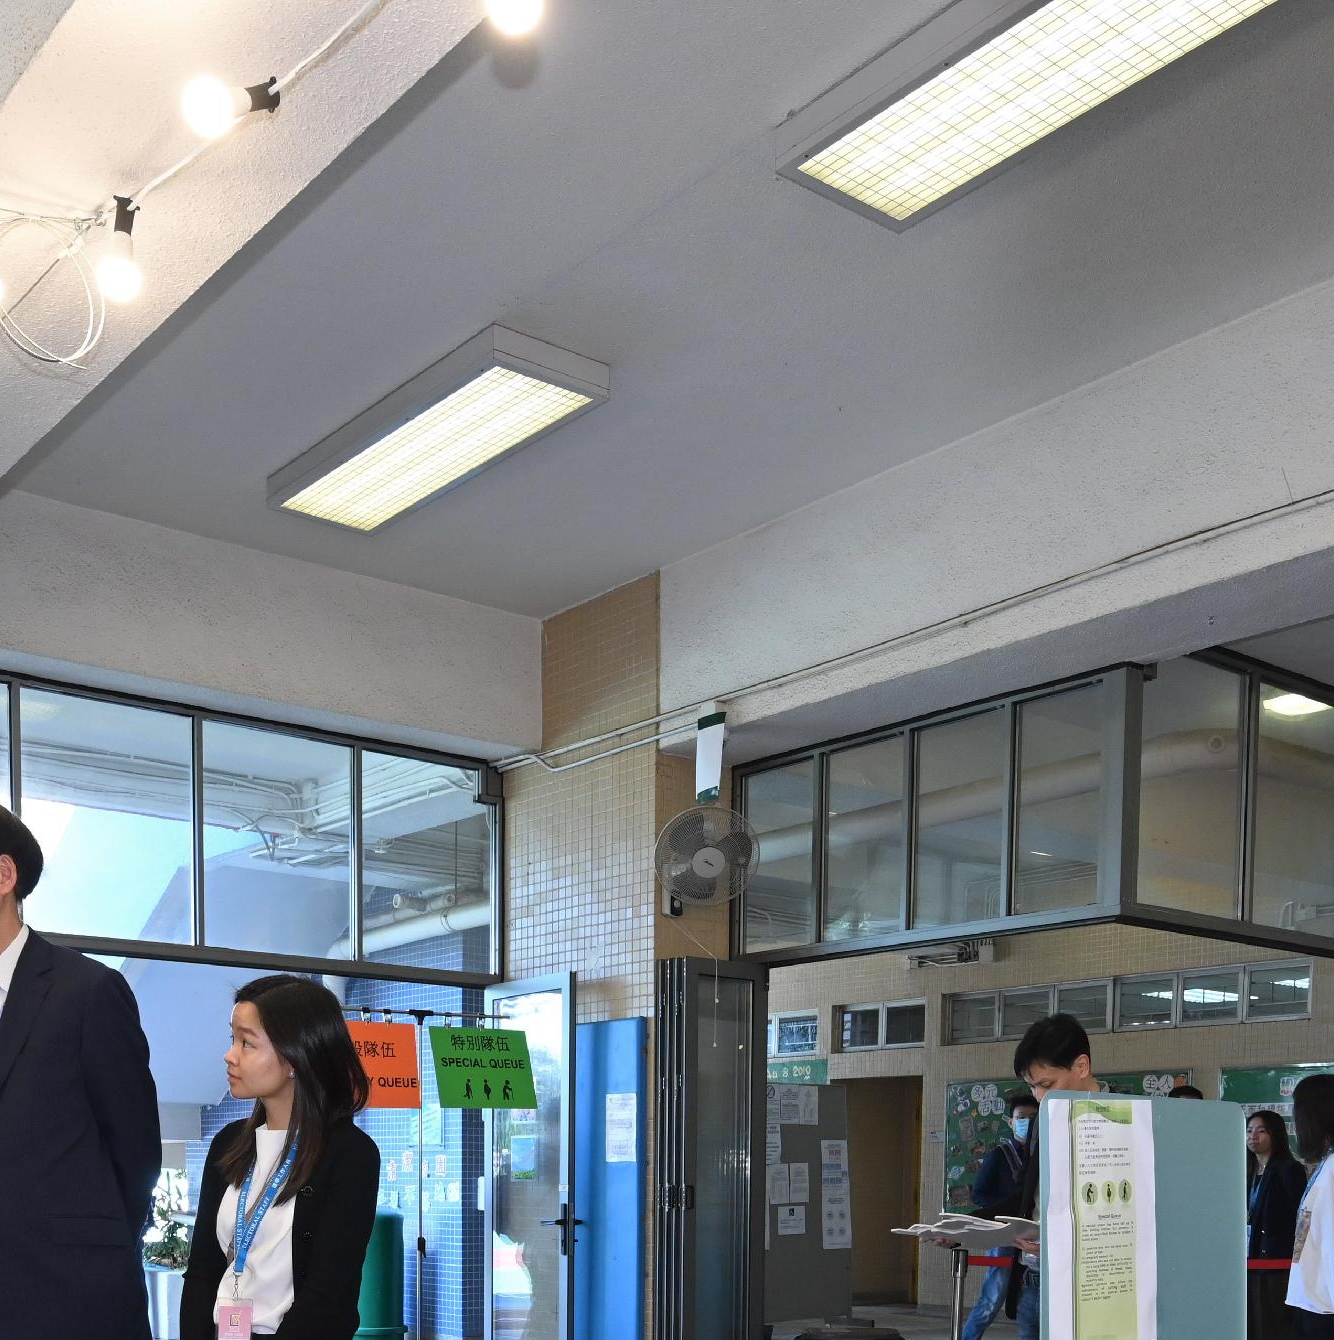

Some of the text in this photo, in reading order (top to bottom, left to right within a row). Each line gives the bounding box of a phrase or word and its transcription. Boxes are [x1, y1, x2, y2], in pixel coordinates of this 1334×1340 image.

[450, 1034, 510, 1052] 特別隊伍
[441, 1057, 525, 1069] SPECIAL QUEUE
[378, 1076, 418, 1088] QUEUE
